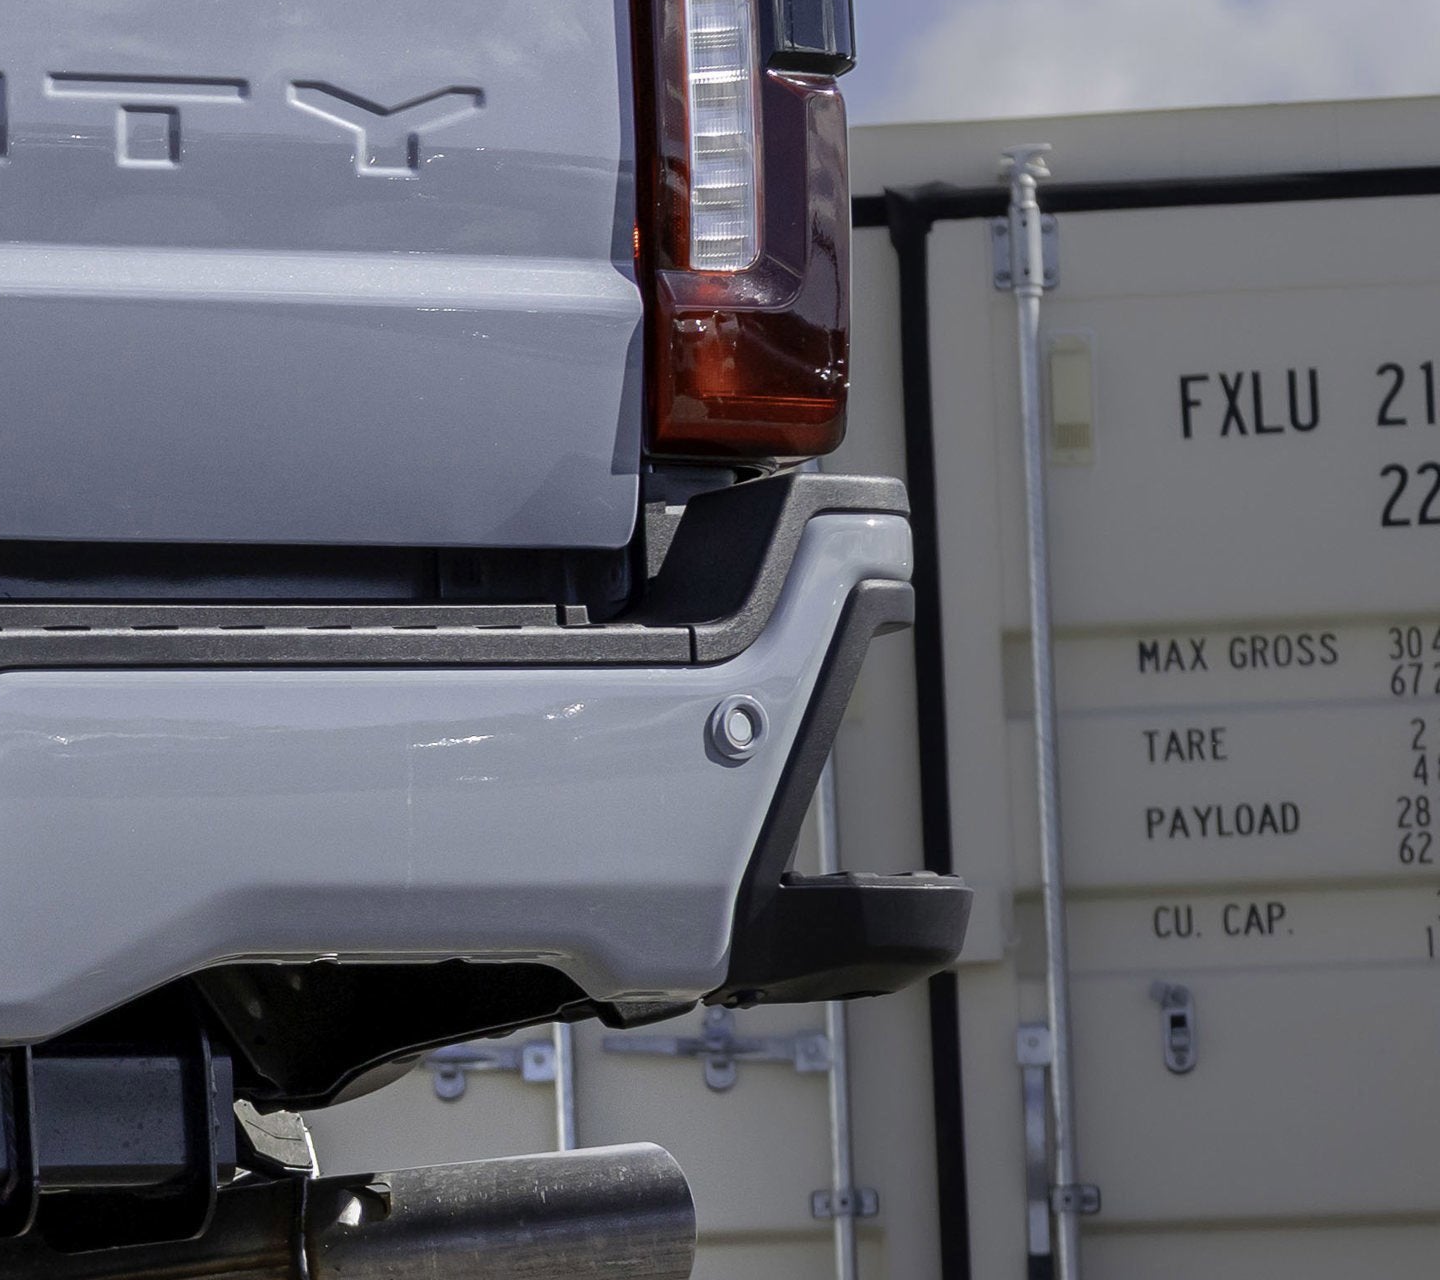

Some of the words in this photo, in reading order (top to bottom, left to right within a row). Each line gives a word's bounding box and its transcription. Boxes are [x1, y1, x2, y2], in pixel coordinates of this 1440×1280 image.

[1179, 367, 1320, 440] FXLU
[1375, 360, 1437, 427] 21
[1379, 461, 1440, 527] 22
[1137, 637, 1209, 673] MAX
[1229, 633, 1339, 670] GROSS
[1388, 625, 1423, 660] 30
[1390, 662, 1424, 696] 67
[1142, 726, 1228, 763] TARE
[1410, 717, 1426, 751] 2
[1145, 801, 1301, 839] PAYLOAD
[1397, 795, 1431, 829] 28
[1399, 831, 1433, 865] 62
[1153, 904, 1202, 939] CU.
[1223, 901, 1294, 936] CAP.
